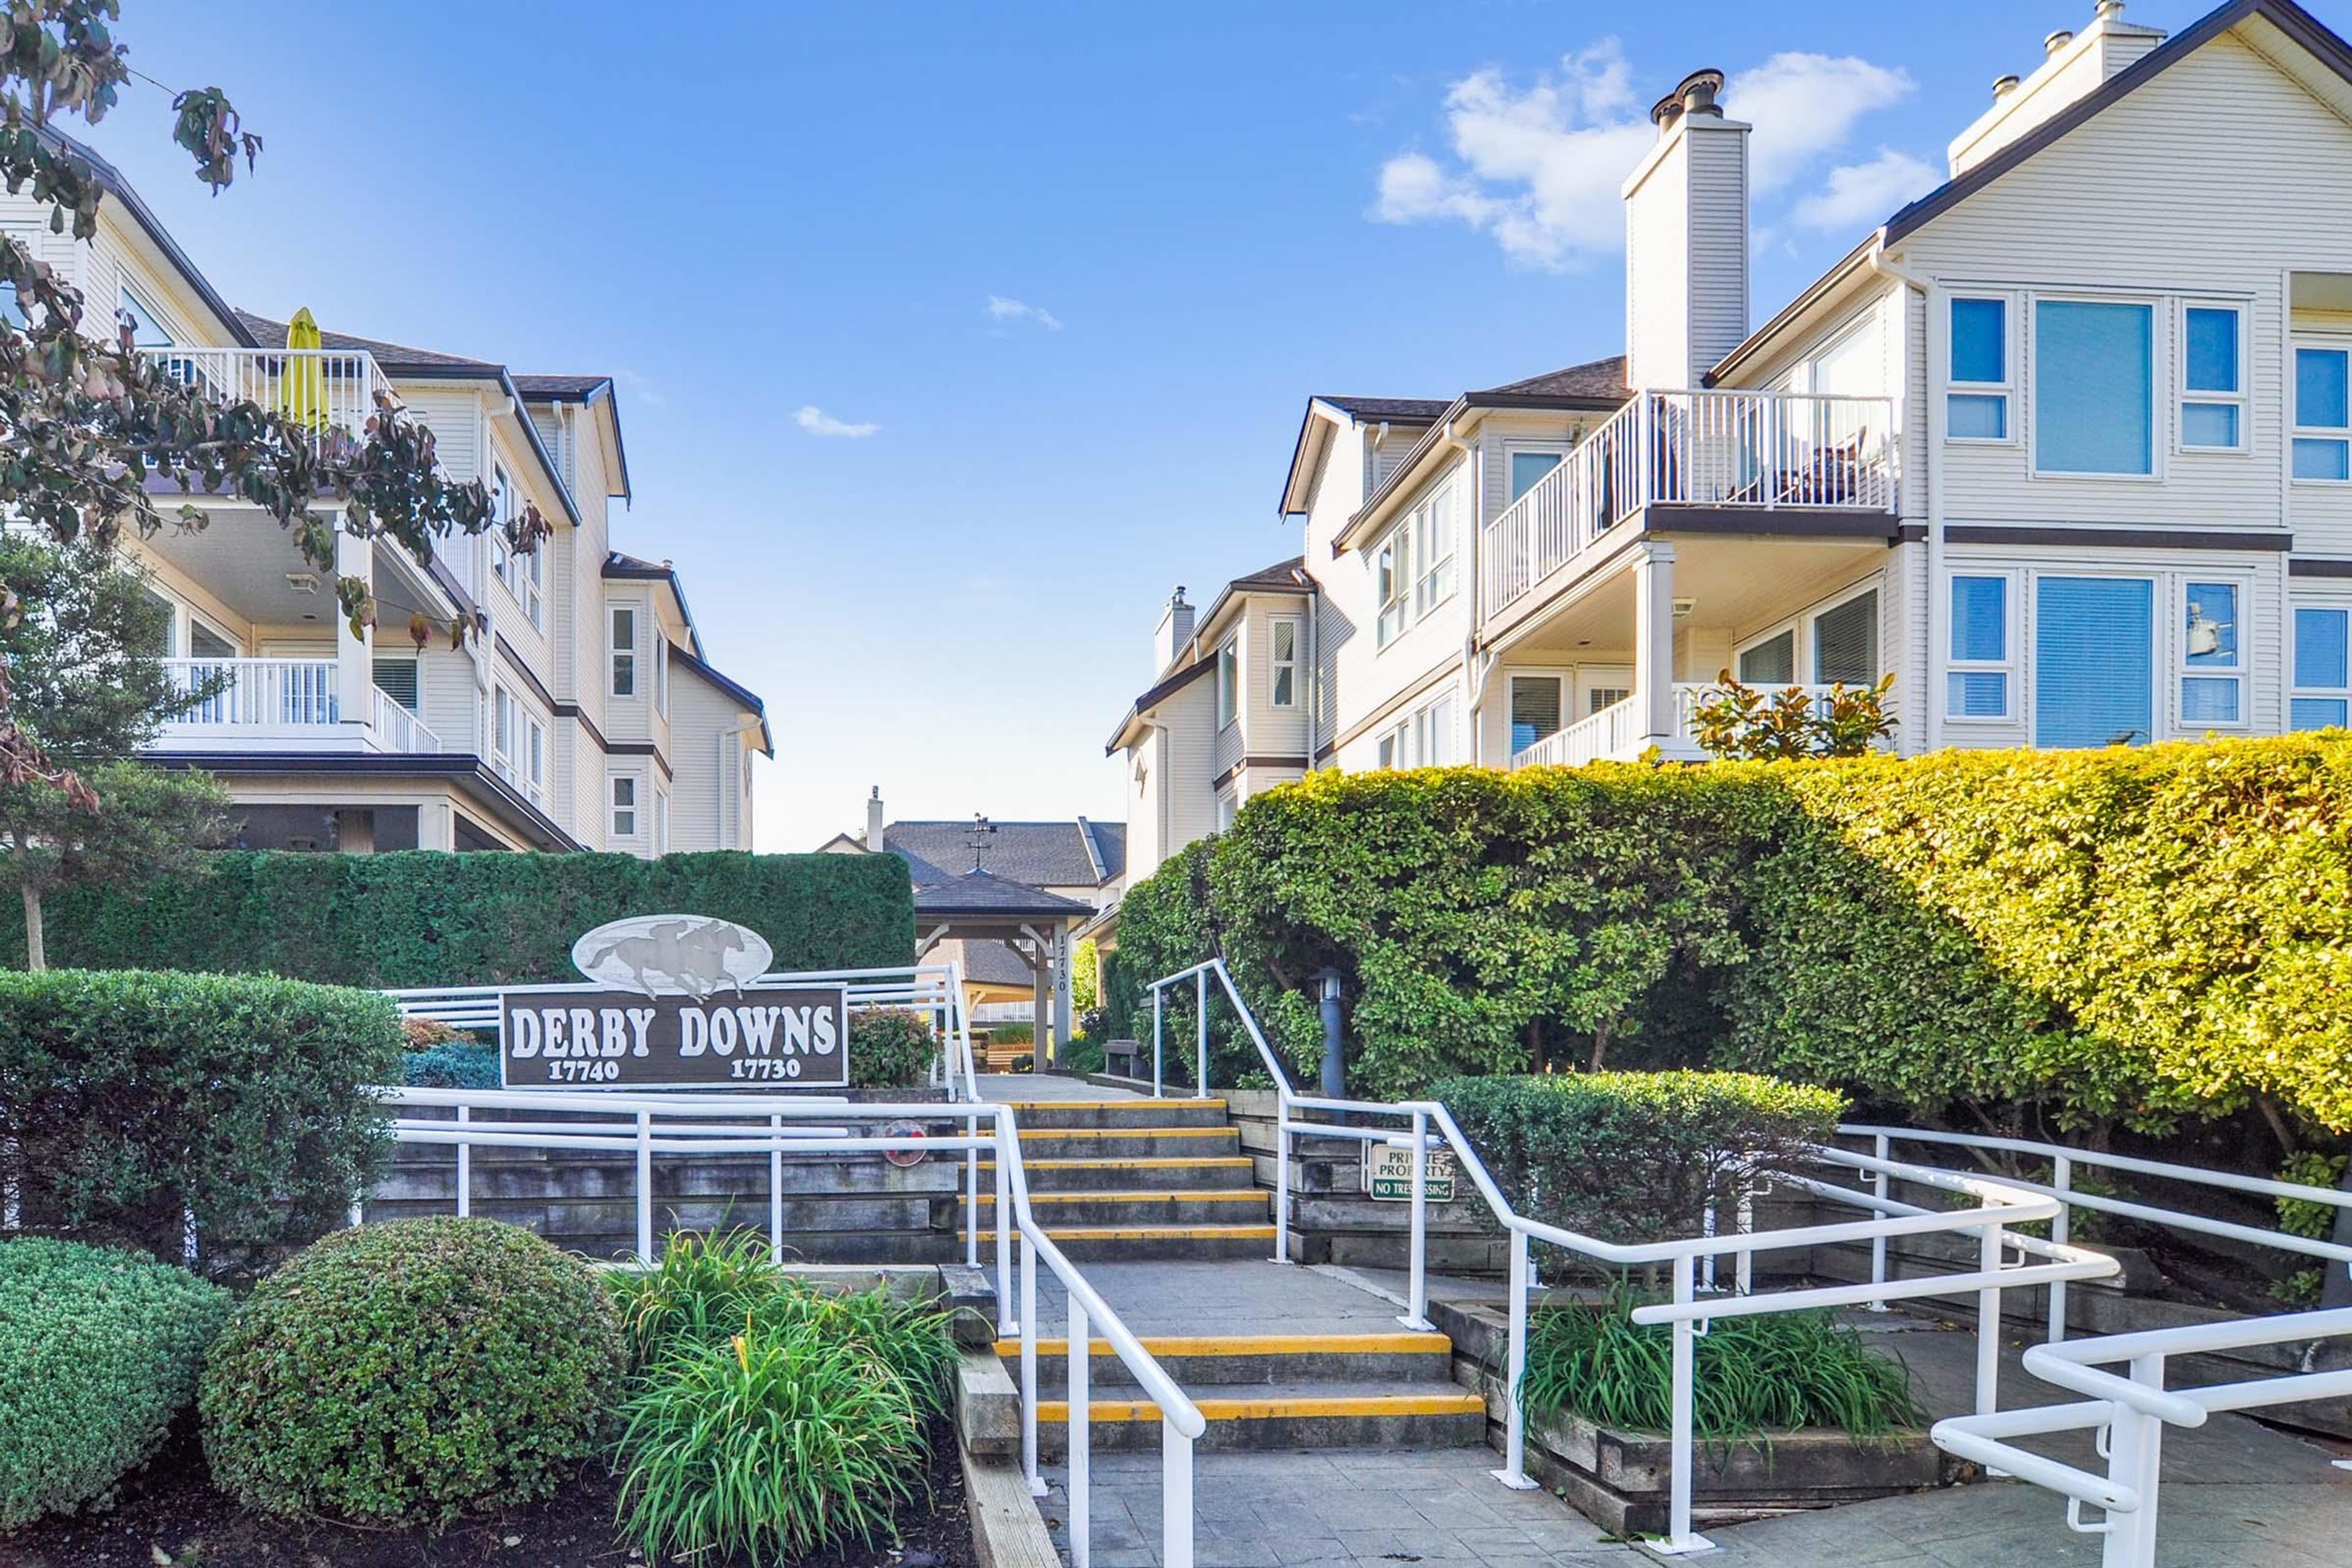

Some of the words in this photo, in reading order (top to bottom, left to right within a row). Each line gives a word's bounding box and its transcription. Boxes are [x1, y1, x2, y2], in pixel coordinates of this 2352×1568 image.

[510, 1008, 656, 1058] DERBY
[678, 1005, 837, 1057] DOWNS
[549, 1061, 620, 1082] 17740
[731, 1059, 801, 1080] 17730
[1389, 1152, 1441, 1164] PRITE
[1379, 1164, 1446, 1176] PROPRTY
[1376, 1183, 1390, 1194] NO
[1393, 1183, 1449, 1196] TRESSSING
